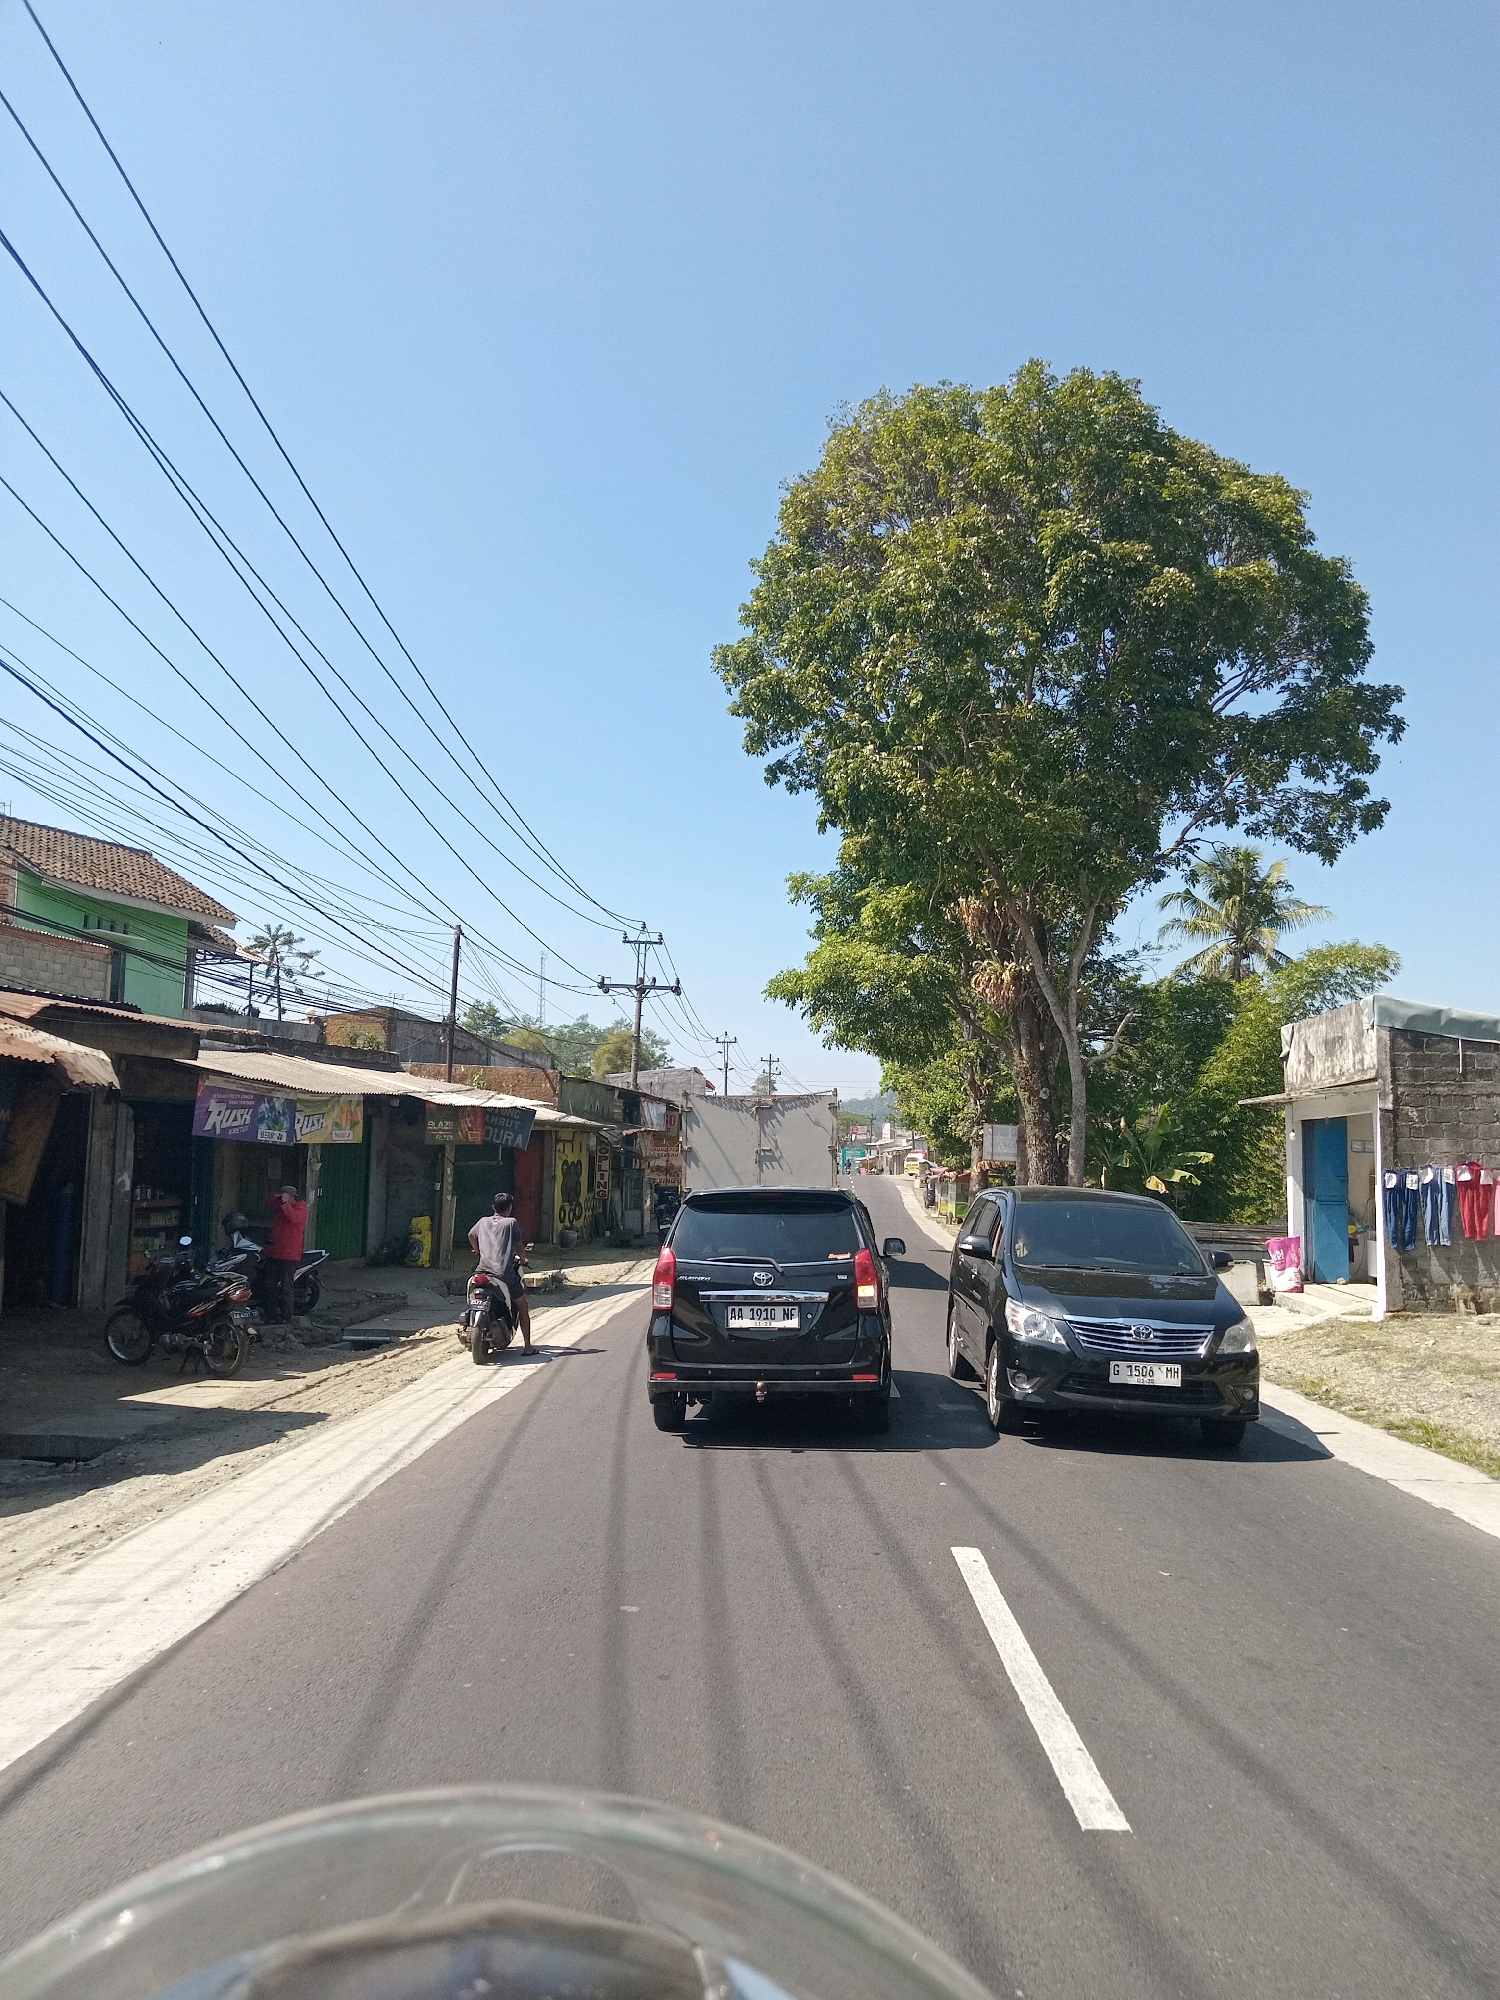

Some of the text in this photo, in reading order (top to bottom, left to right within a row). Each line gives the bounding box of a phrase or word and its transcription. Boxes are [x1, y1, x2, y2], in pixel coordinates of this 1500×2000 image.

[203, 1099, 252, 1135] RUSH
[294, 1111, 326, 1142] RUSH
[730, 1307, 797, 1321] AA 1910 NF
[1113, 1363, 1180, 1379] G 1506 MH
